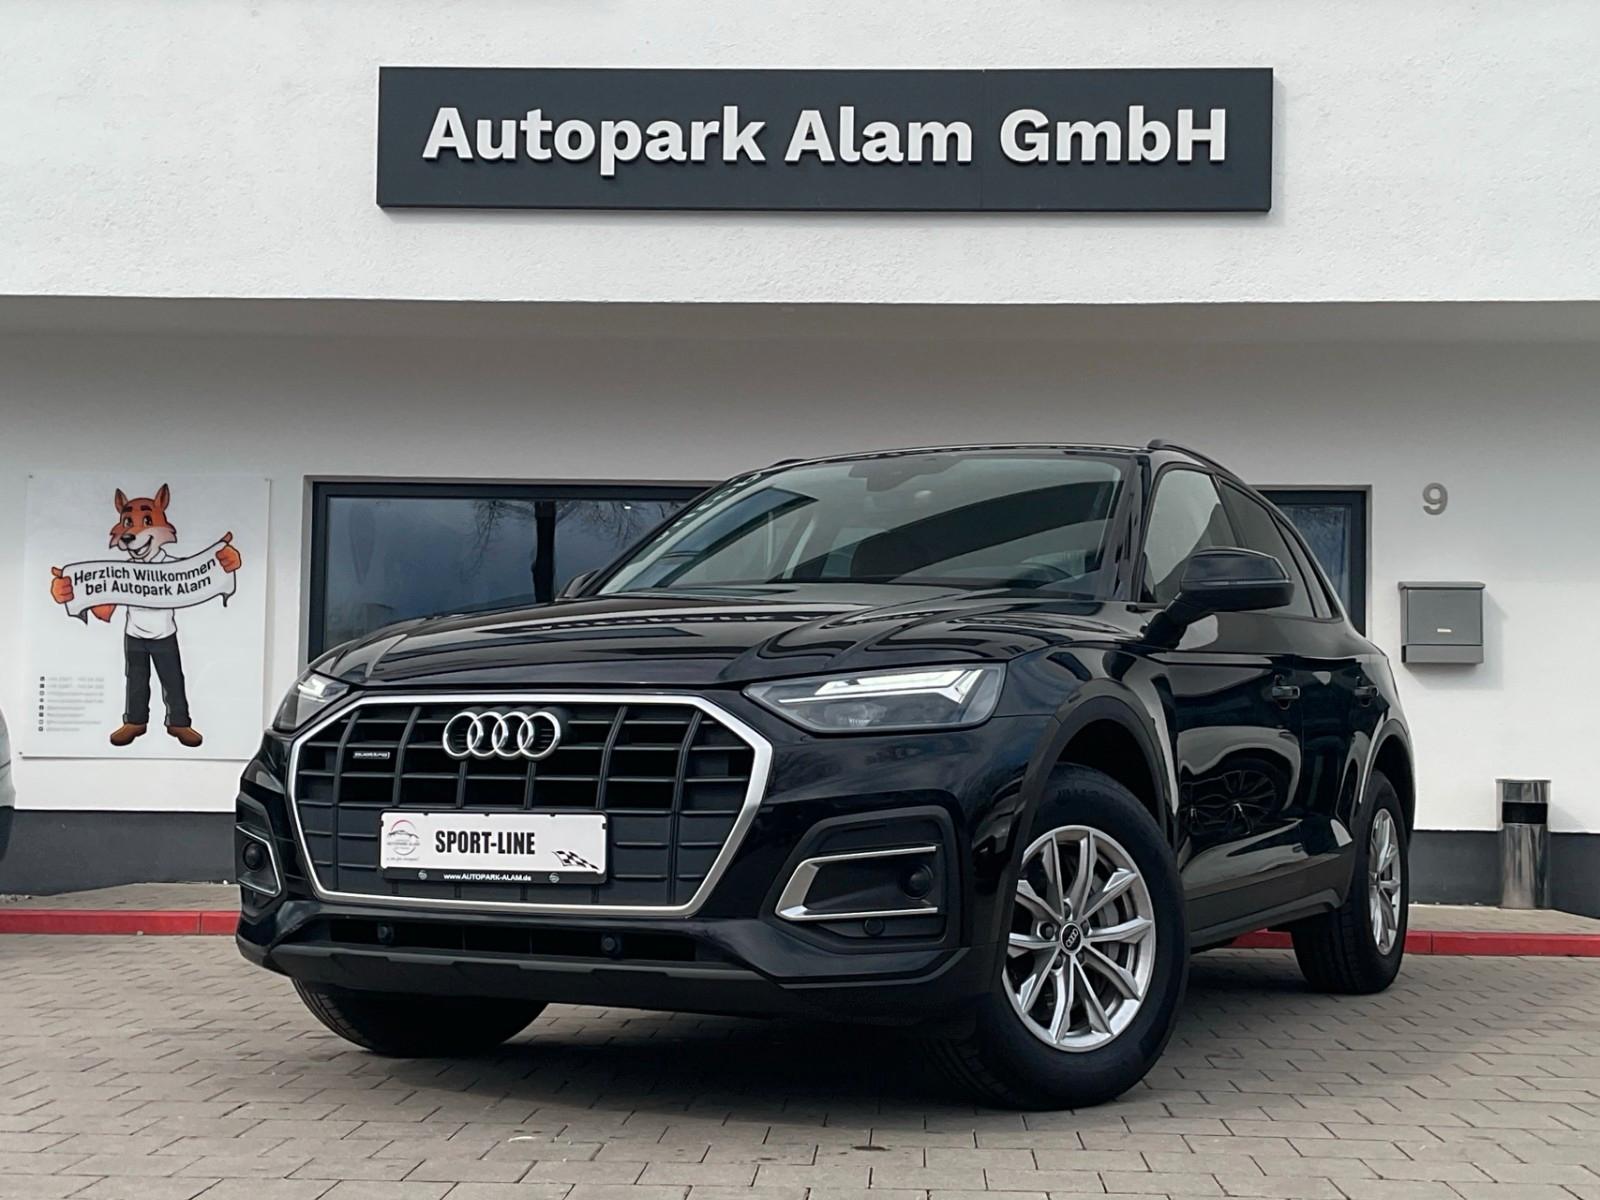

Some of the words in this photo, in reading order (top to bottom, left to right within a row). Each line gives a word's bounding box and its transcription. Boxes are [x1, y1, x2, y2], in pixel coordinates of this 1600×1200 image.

[422, 105, 767, 178] Autopark
[784, 105, 973, 165] Alam
[999, 104, 1227, 165] GmbH
[1422, 482, 1449, 516] 9
[74, 566, 130, 586] Herzlich
[133, 558, 216, 582] Willkommen
[85, 580, 107, 596] bei
[111, 580, 173, 597] Autopark
[176, 576, 212, 595] Alam
[435, 830, 536, 855] SPORT-LINE
